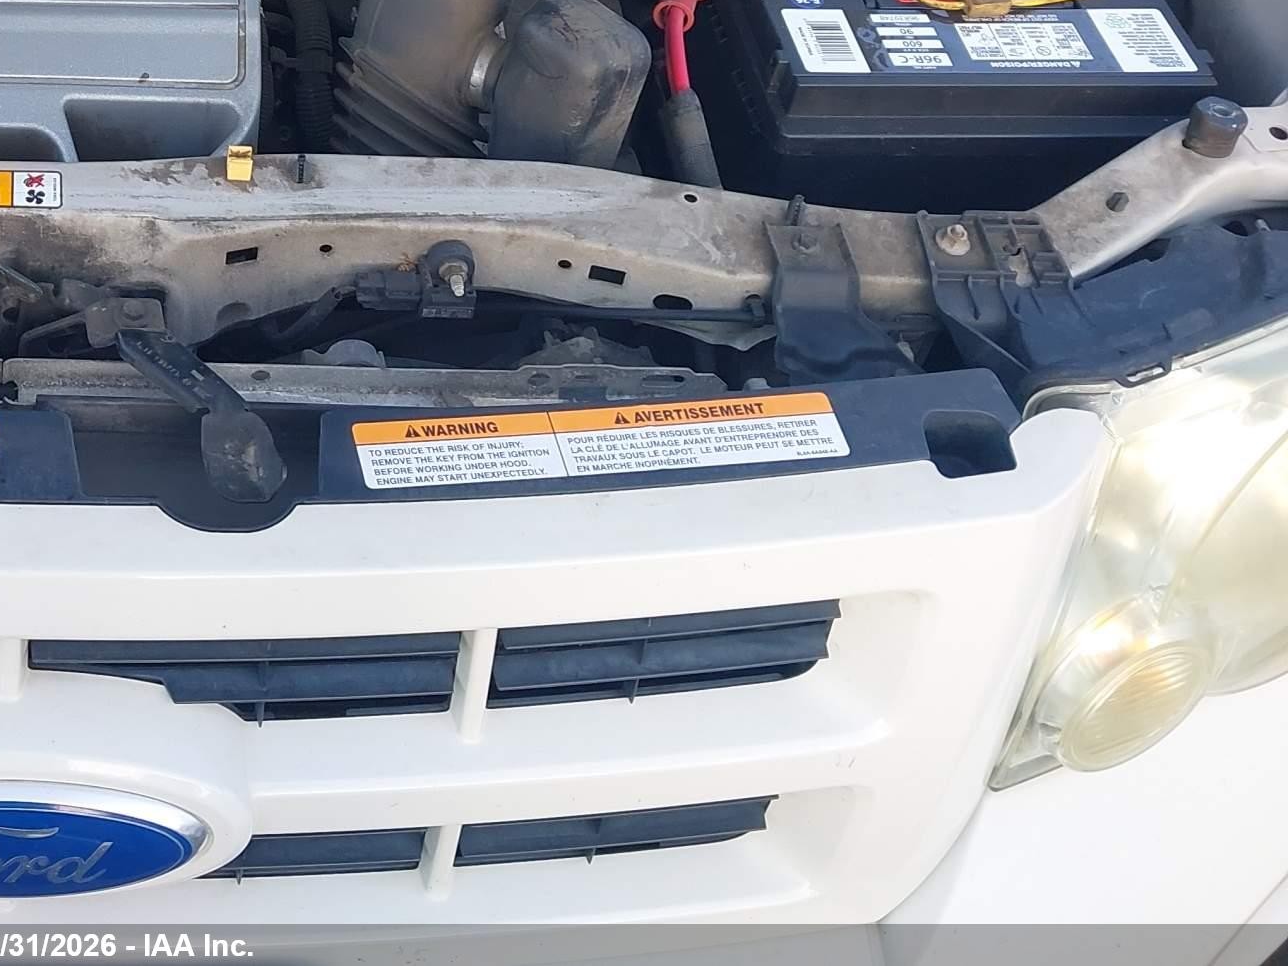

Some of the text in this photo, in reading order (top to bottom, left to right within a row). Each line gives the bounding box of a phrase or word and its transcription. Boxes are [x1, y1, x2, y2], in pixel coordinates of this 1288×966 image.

[902, 40, 923, 48] 600
[899, 54, 942, 64] 96R-C
[634, 402, 763, 423] AVERTISSEMENT
[420, 421, 498, 437] WARNING
[566, 436, 594, 444] POUR
[639, 431, 658, 439] LES
[659, 428, 701, 437] RISQUES
[776, 419, 817, 428] RETIRER
[584, 443, 604, 452] CLÉ
[605, 443, 619, 451] DE
[683, 436, 712, 445] AVANT
[799, 428, 818, 436] DES
[368, 449, 382, 457] TO
[384, 447, 424, 455] REDUCE
[424, 445, 445, 453] THE
[446, 444, 470, 452] RISK
[370, 449, 549, 466] REMOVE THE KEY FROM THE IGNITION
[573, 453, 617, 463] TRAVAUX
[618, 451, 646, 459] SOUS
[646, 449, 660, 457] LE
[699, 446, 712, 454] LE
[713, 443, 754, 452] MOTEUR
[754, 440, 778, 449] PEUT
[781, 439, 794, 447] SE
[795, 437, 834, 446] METTRE
[373, 466, 413, 475] BEFORE
[414, 463, 462, 473] WORKING
[464, 461, 497, 470] UNDER
[591, 461, 633, 471] MARCHE
[375, 476, 412, 485] ENGINE
[414, 474, 434, 482] MAY
[437, 472, 467, 481] START
